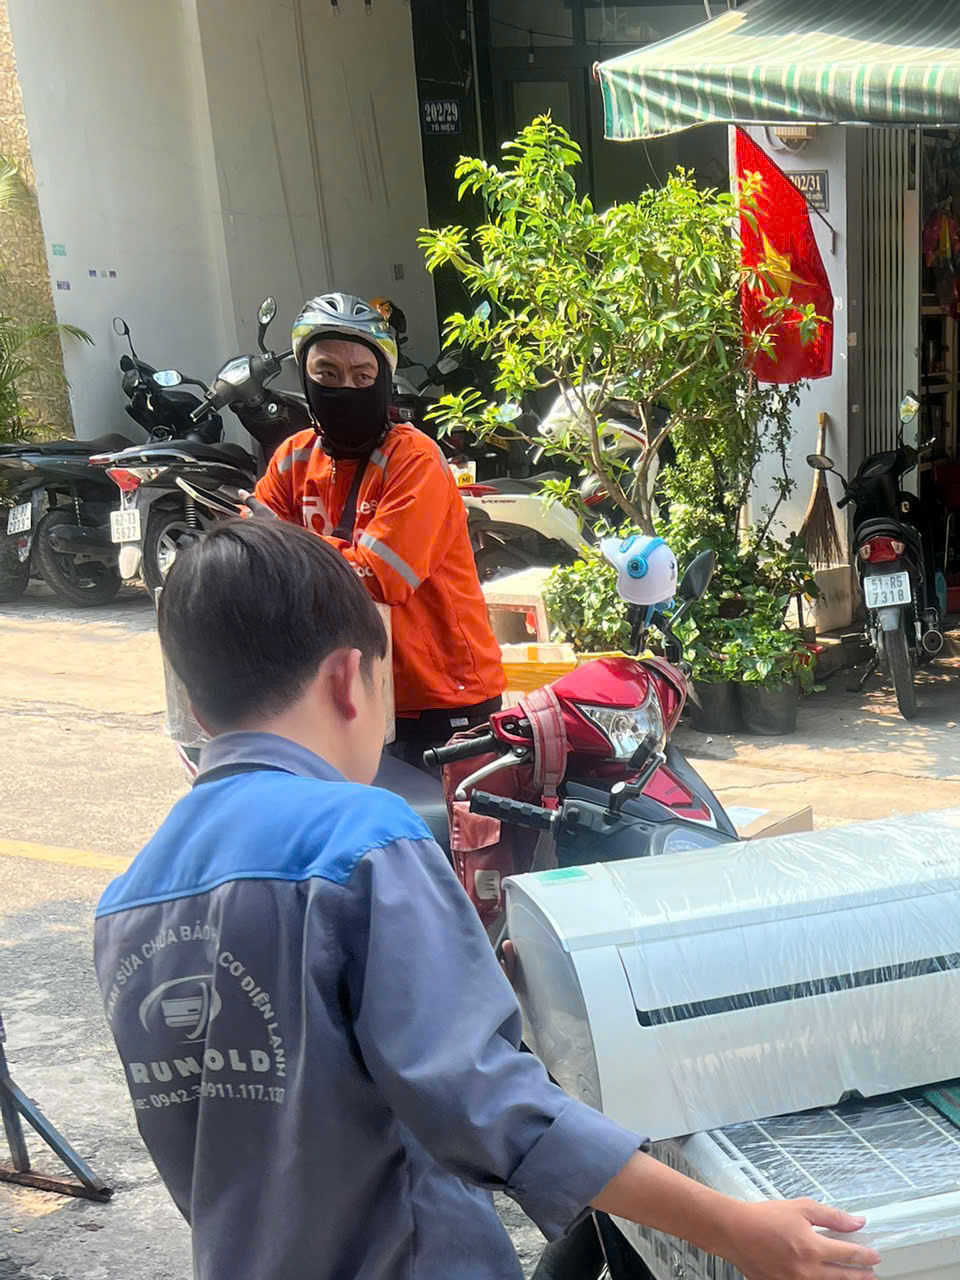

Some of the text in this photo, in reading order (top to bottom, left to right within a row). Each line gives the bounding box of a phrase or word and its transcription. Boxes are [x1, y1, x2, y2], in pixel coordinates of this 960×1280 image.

[424, 102, 458, 121] 202/29
[871, 575, 903, 592] 51-R6
[873, 589, 904, 605] 7318
